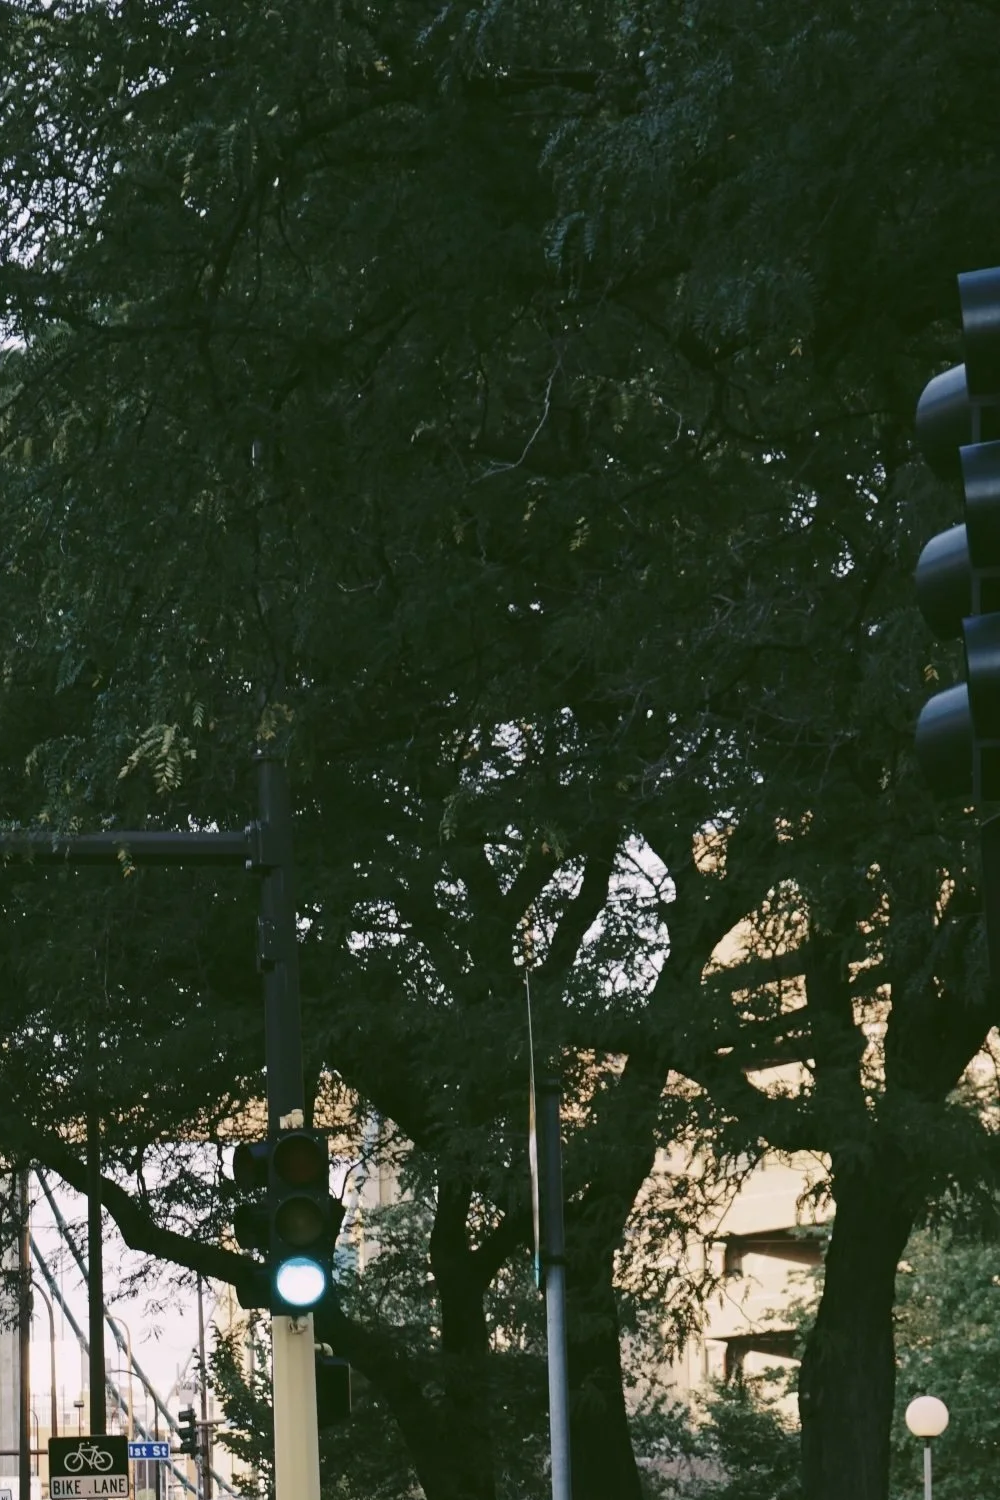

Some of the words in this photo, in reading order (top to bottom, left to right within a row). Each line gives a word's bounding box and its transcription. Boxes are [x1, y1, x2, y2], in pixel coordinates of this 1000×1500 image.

[129, 1446, 147, 1457] 1st
[152, 1445, 167, 1457] St
[53, 1479, 82, 1495] BIKE
[94, 1478, 126, 1494] LANE
